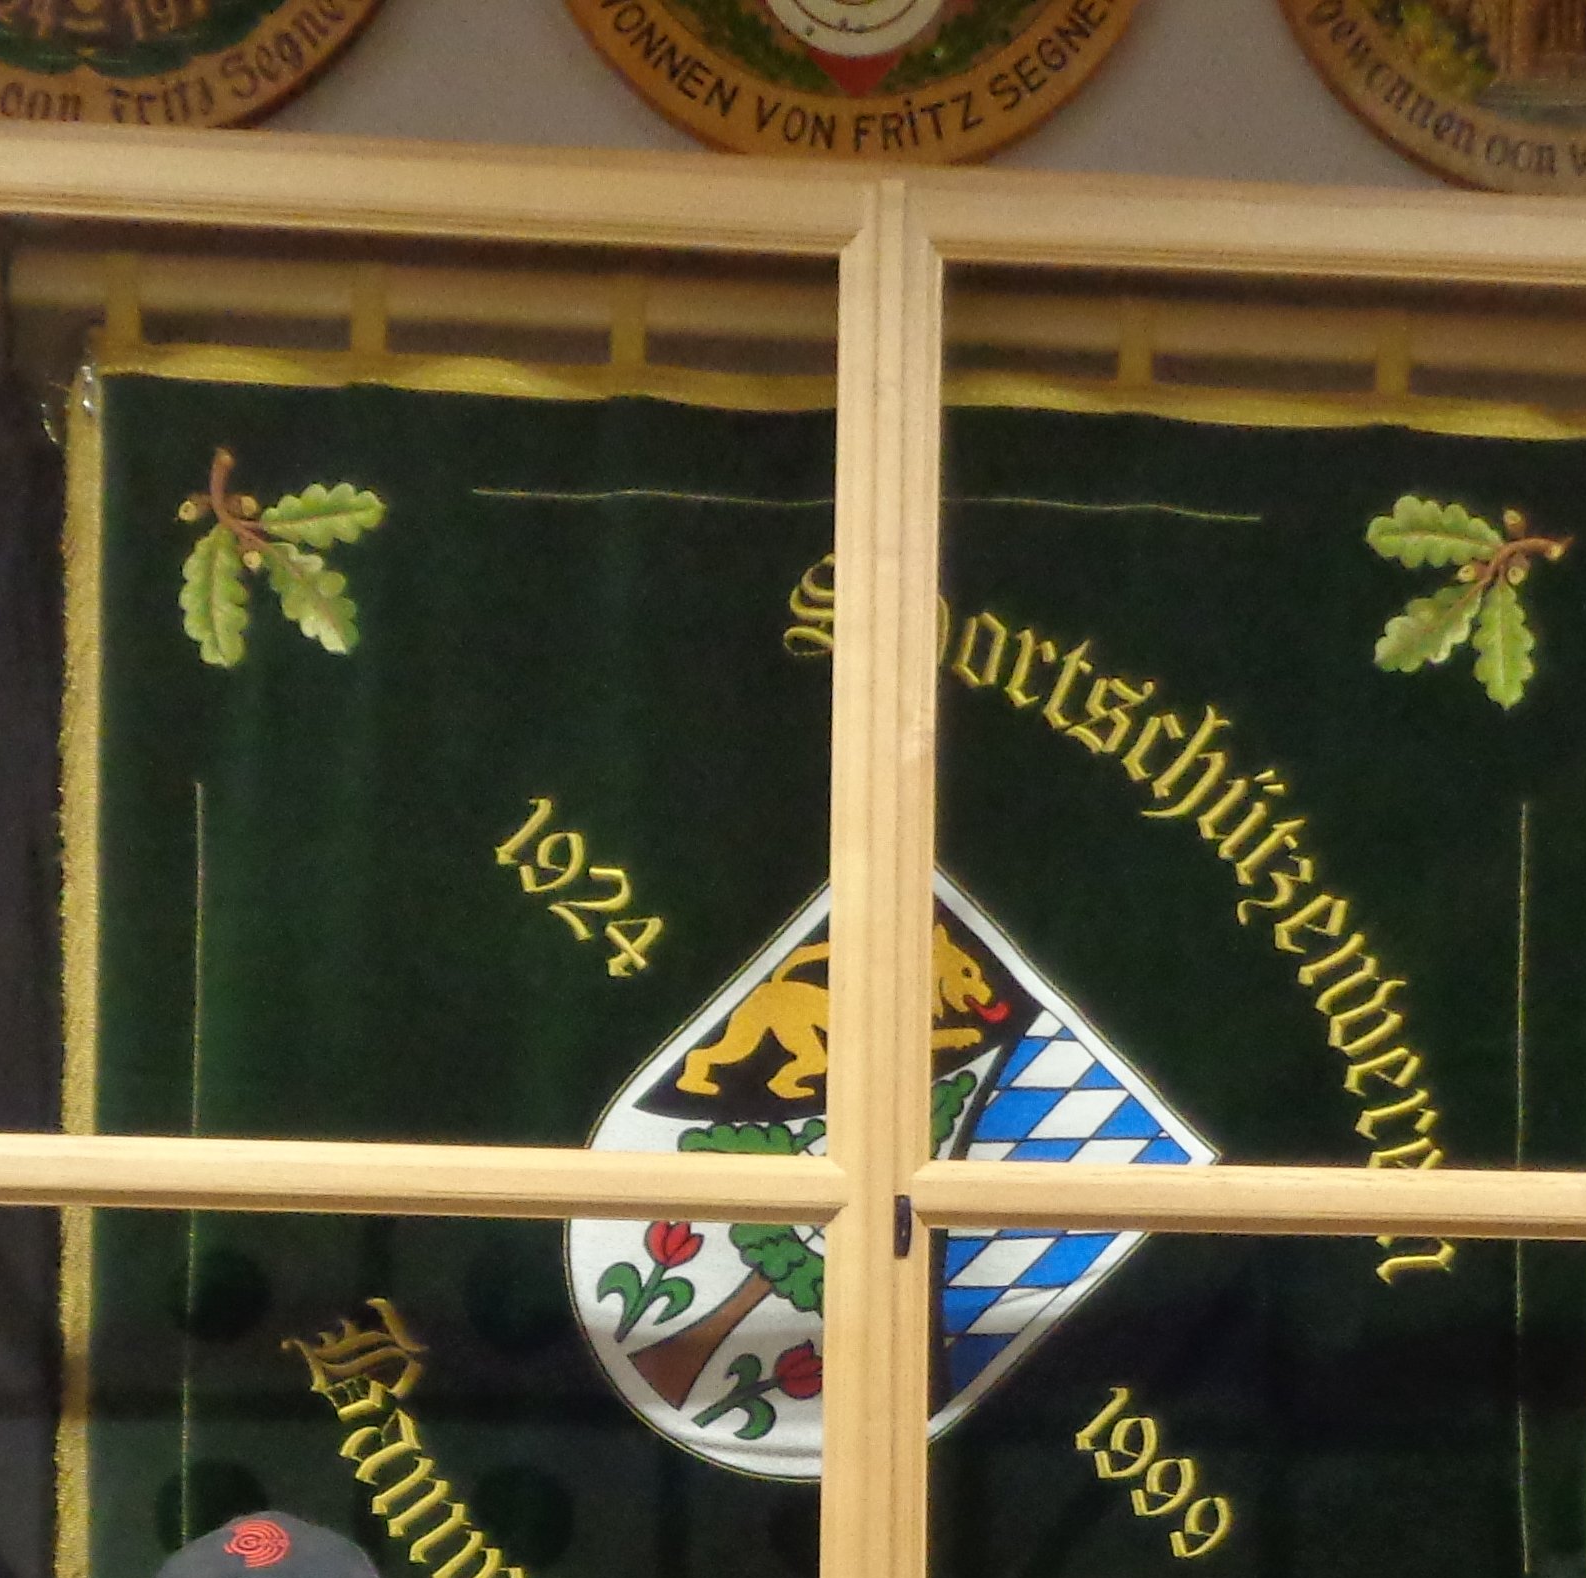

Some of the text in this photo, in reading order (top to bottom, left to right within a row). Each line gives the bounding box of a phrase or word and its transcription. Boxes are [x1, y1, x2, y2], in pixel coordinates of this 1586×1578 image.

[754, 95, 836, 151] VON
[494, 795, 665, 979] 1924
[782, 551, 1458, 1285] Sortschützenveren
[1074, 1387, 1234, 1562] 1999
